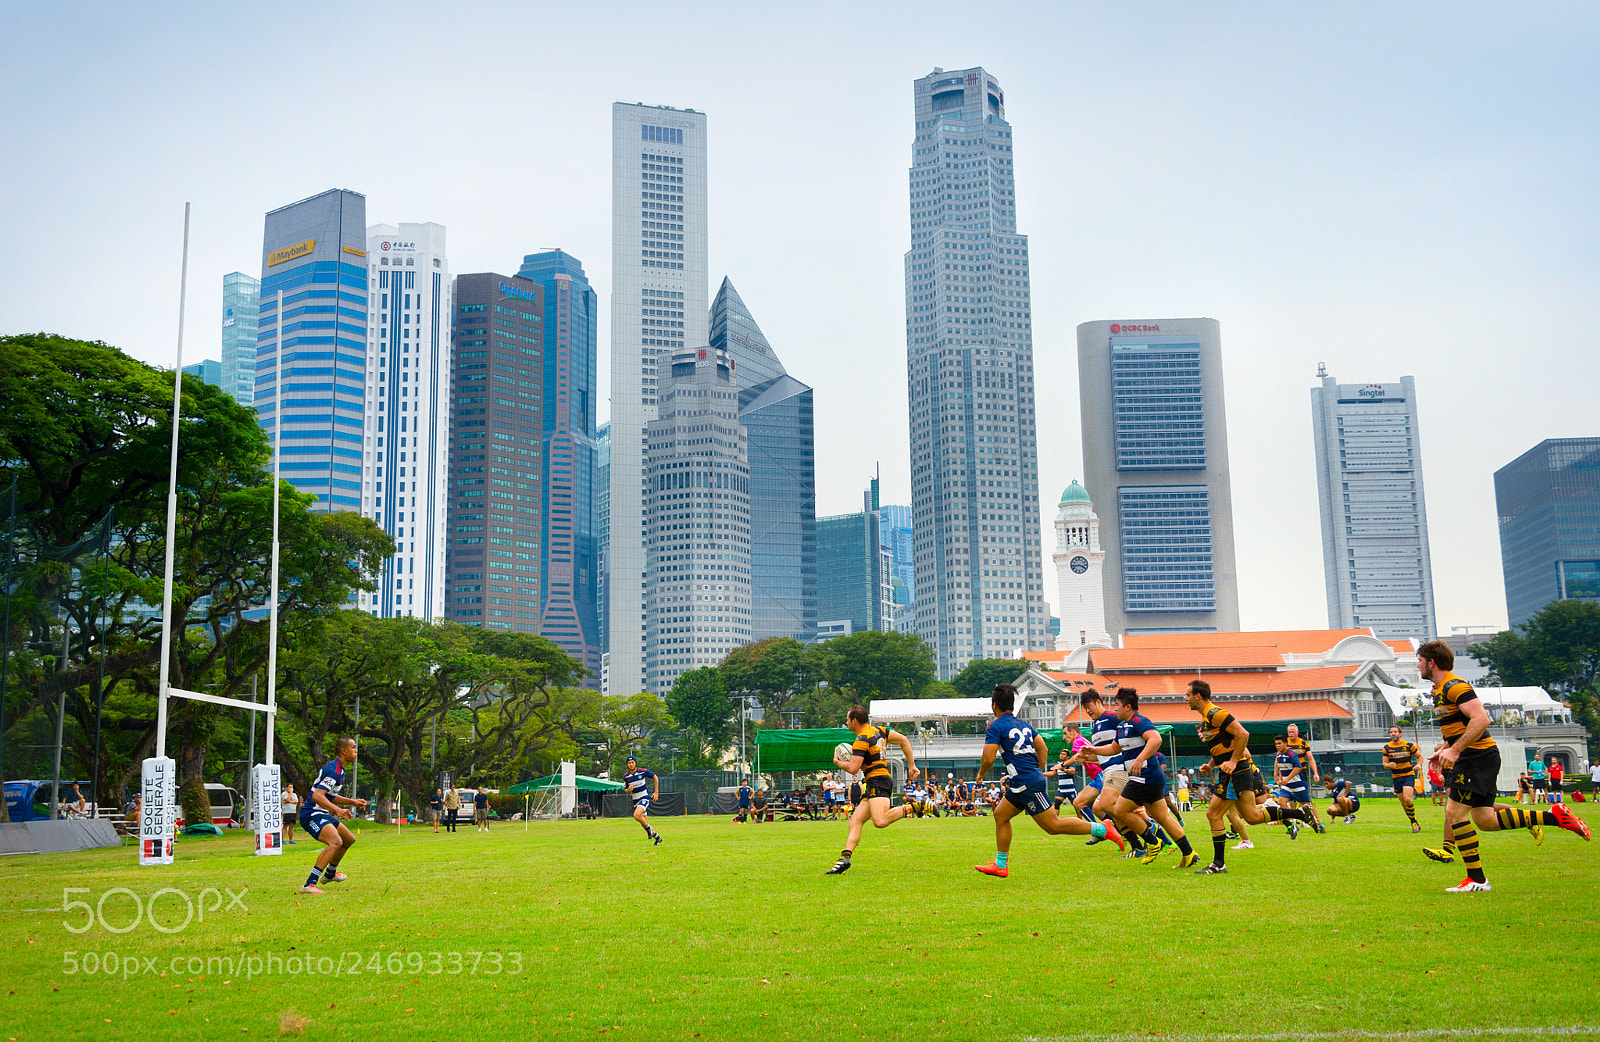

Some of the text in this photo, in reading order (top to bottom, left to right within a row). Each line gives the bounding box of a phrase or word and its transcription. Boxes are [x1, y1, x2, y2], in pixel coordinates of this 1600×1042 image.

[276, 243, 308, 261] Maybank
[498, 281, 536, 301] CapitaLand
[1121, 324, 1160, 332] OCBC Bank
[1358, 389, 1386, 399] Singtel
[1008, 727, 1036, 756] 23
[144, 778, 154, 835] SOCIETE
[153, 764, 165, 836] GENERALE
[262, 780, 272, 829] SOCIETE
[270, 768, 281, 828] GENERALE
